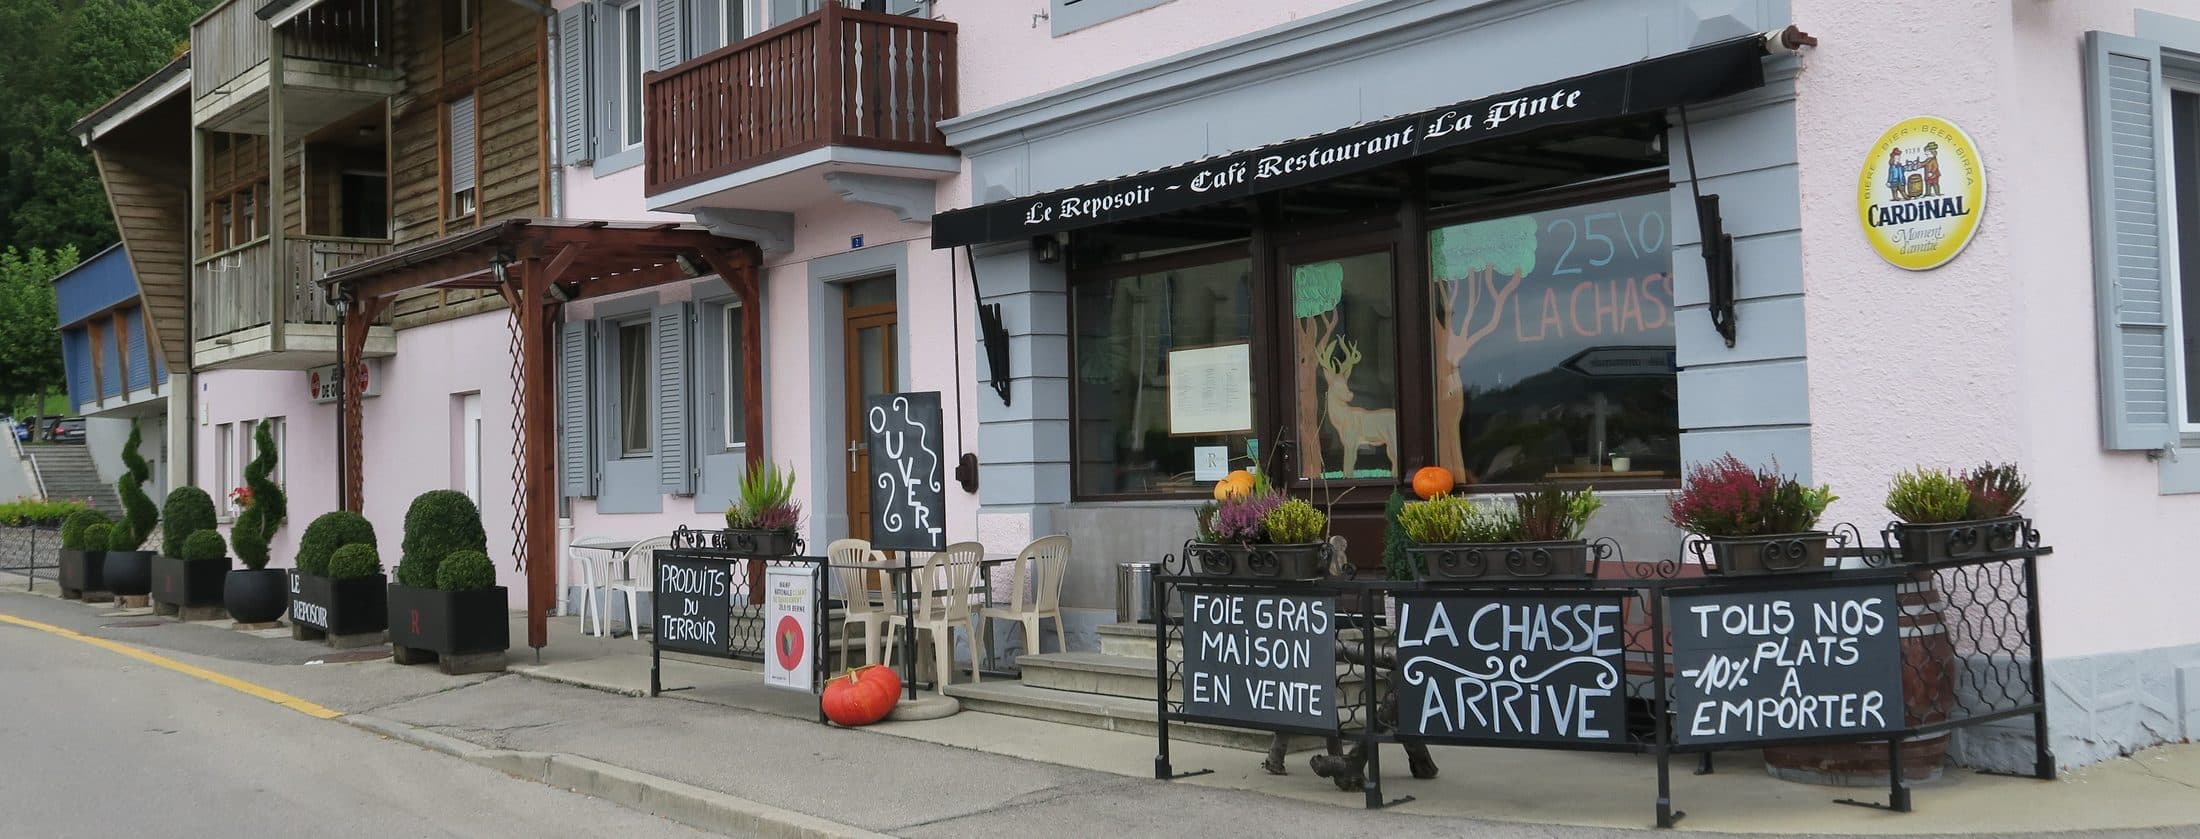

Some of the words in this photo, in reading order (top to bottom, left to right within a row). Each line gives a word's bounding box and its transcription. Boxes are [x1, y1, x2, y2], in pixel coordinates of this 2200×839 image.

[1024, 201, 1052, 226] Le
[1059, 185, 1154, 220] Reposoir
[1190, 160, 1246, 193] Café
[1254, 124, 1415, 181] Restaurant
[1423, 111, 1473, 141] La
[1483, 88, 1582, 130] Pinte
[1881, 128, 1909, 151] BIER
[1921, 124, 1953, 142] BEER
[1955, 148, 1974, 186] BIRRA
[1892, 226, 1945, 242] Moment
[1514, 287, 1564, 342] LA
[869, 405, 942, 548] OUVERT
[290, 573, 300, 594] LE
[293, 599, 328, 629] REPOSOIR
[683, 598, 699, 616] DU
[1256, 598, 1328, 635] GRAS
[1690, 600, 1794, 637] TOUS
[1813, 598, 1884, 635] NOS
[1399, 601, 1459, 647] LA
[1468, 602, 1622, 656] CHASSE
[1753, 636, 1859, 673] PLATS
[1193, 671, 1231, 706] EN
[1246, 677, 1322, 716] VENTE
[1781, 667, 1802, 697] A
[1690, 690, 1886, 736] EMPORTER
